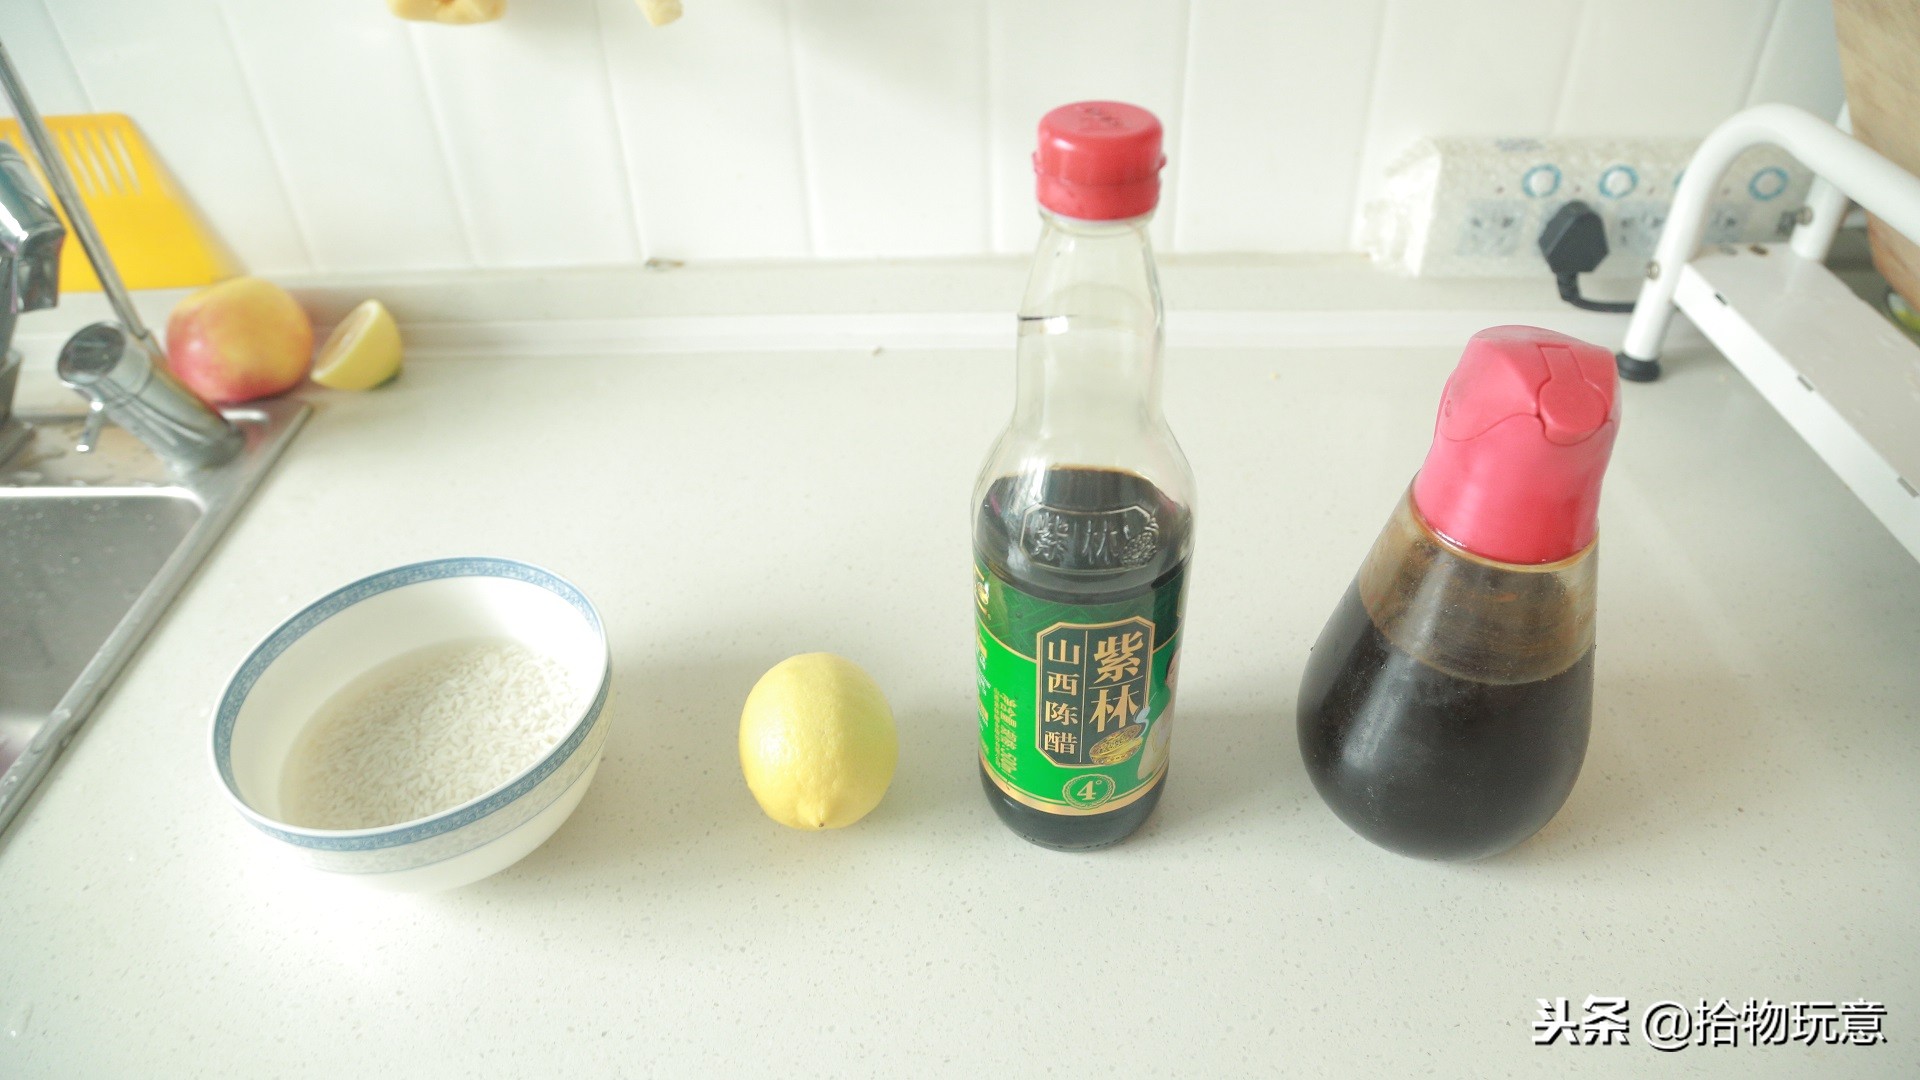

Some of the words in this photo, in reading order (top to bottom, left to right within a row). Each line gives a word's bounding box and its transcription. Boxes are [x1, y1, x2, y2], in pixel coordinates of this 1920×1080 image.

[1044, 638, 1081, 755] 山西陈醋
[1088, 631, 1144, 733] 紫林
